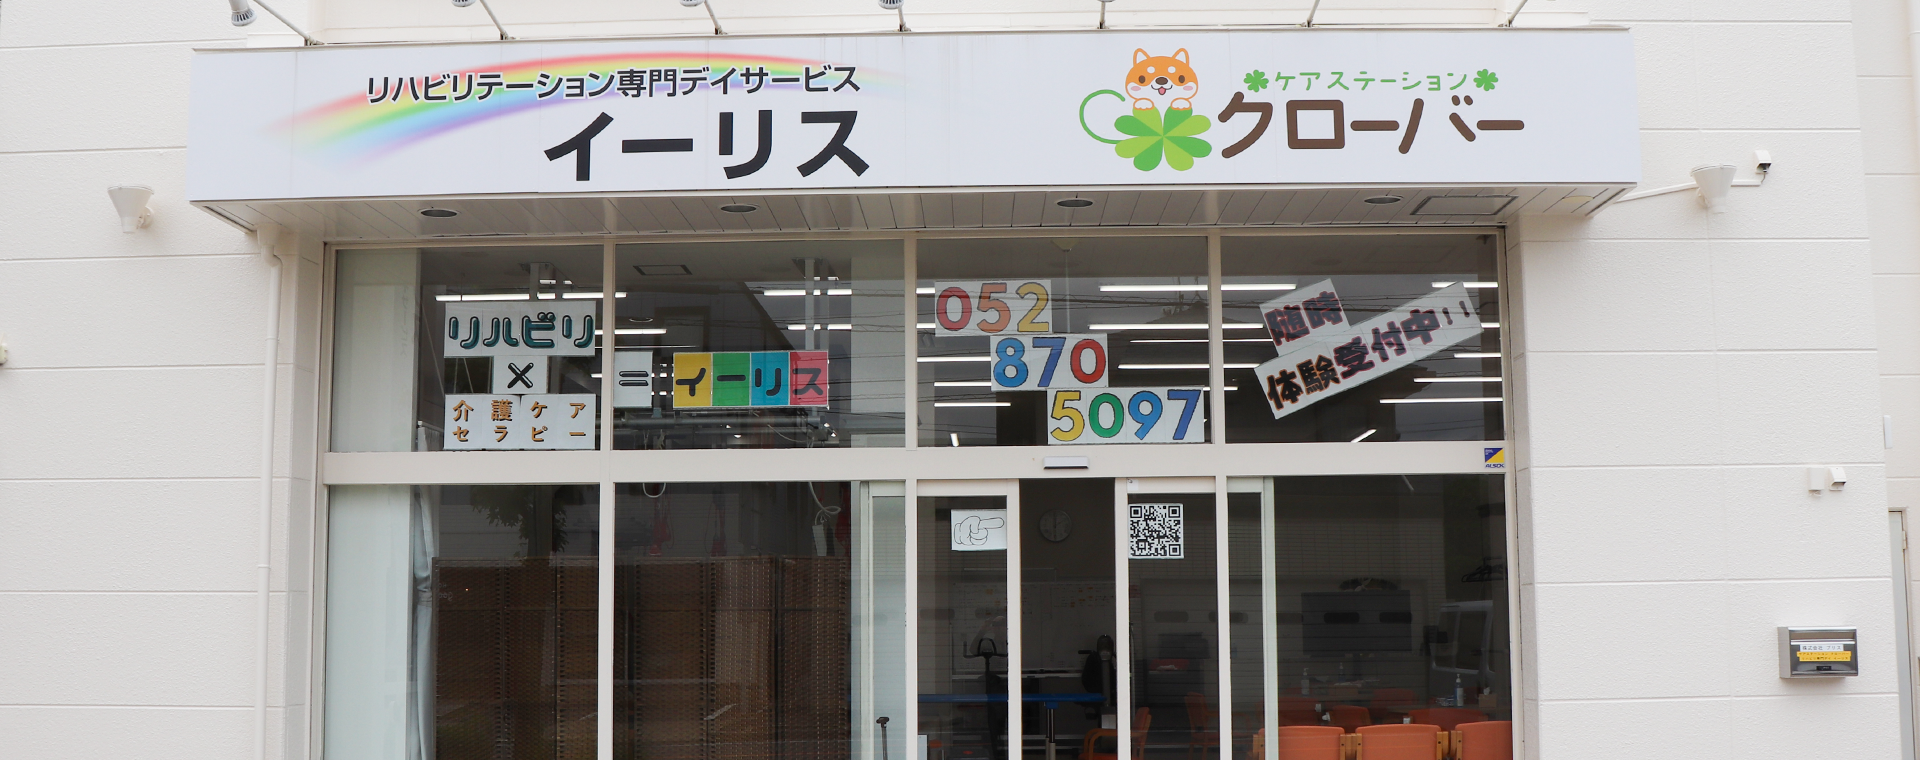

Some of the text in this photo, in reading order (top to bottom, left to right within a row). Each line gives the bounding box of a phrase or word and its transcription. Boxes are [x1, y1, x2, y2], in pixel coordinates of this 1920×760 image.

[366, 66, 861, 104] リハビリテーション専門デイサービス
[1274, 71, 1468, 91] ケアステーション
[543, 109, 870, 181] イーリス
[1217, 91, 1525, 159] クローバー
[449, 311, 595, 349] リハビリ
[936, 282, 1050, 334] 052
[1264, 290, 1344, 346] 随時
[675, 367, 824, 397] イーリス
[993, 337, 1107, 388] 870
[452, 399, 587, 422] 介護ケア
[1050, 389, 1202, 442] 5097
[452, 425, 587, 443] セラピー
